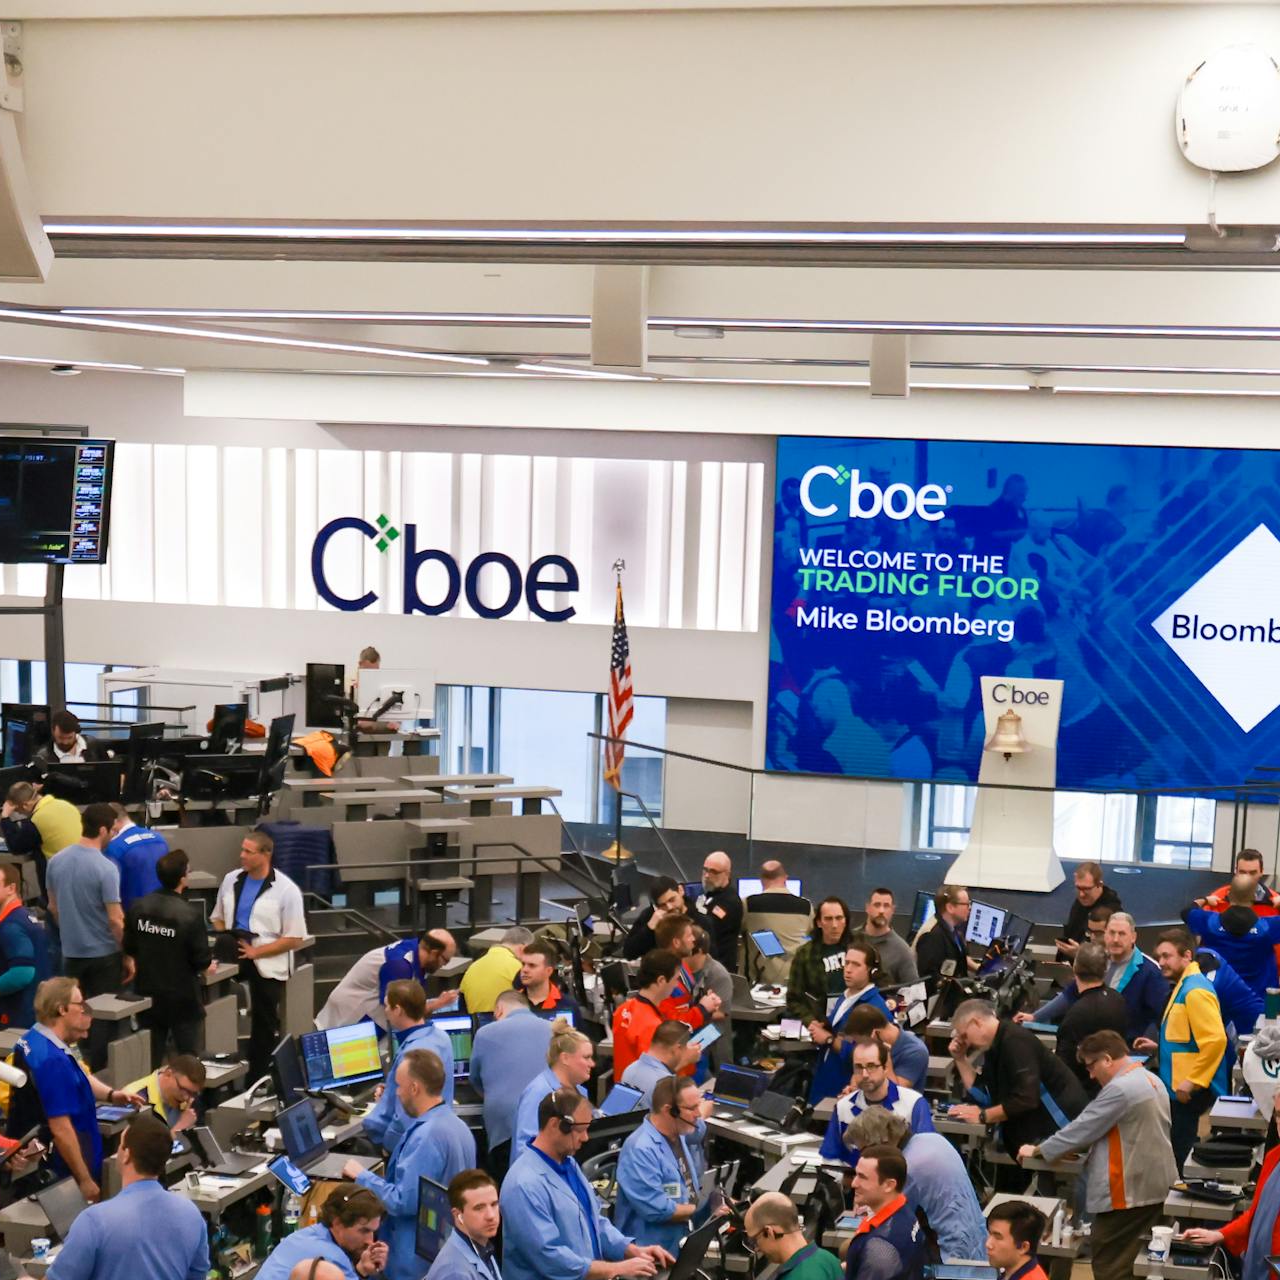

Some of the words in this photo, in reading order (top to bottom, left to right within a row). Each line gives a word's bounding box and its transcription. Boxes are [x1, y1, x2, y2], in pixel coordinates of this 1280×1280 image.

[799, 464, 948, 521] Cboe
[312, 516, 579, 622] Cboe
[799, 548, 917, 571] WELCOME
[922, 553, 953, 572] TO
[958, 554, 1004, 574] THE
[798, 568, 929, 596] TRADING
[938, 574, 1040, 600] FLOOR
[796, 606, 858, 630] Mike
[866, 609, 1015, 643] Bloomberg
[992, 684, 1049, 705] Cboe
[137, 918, 176, 938] Maven
